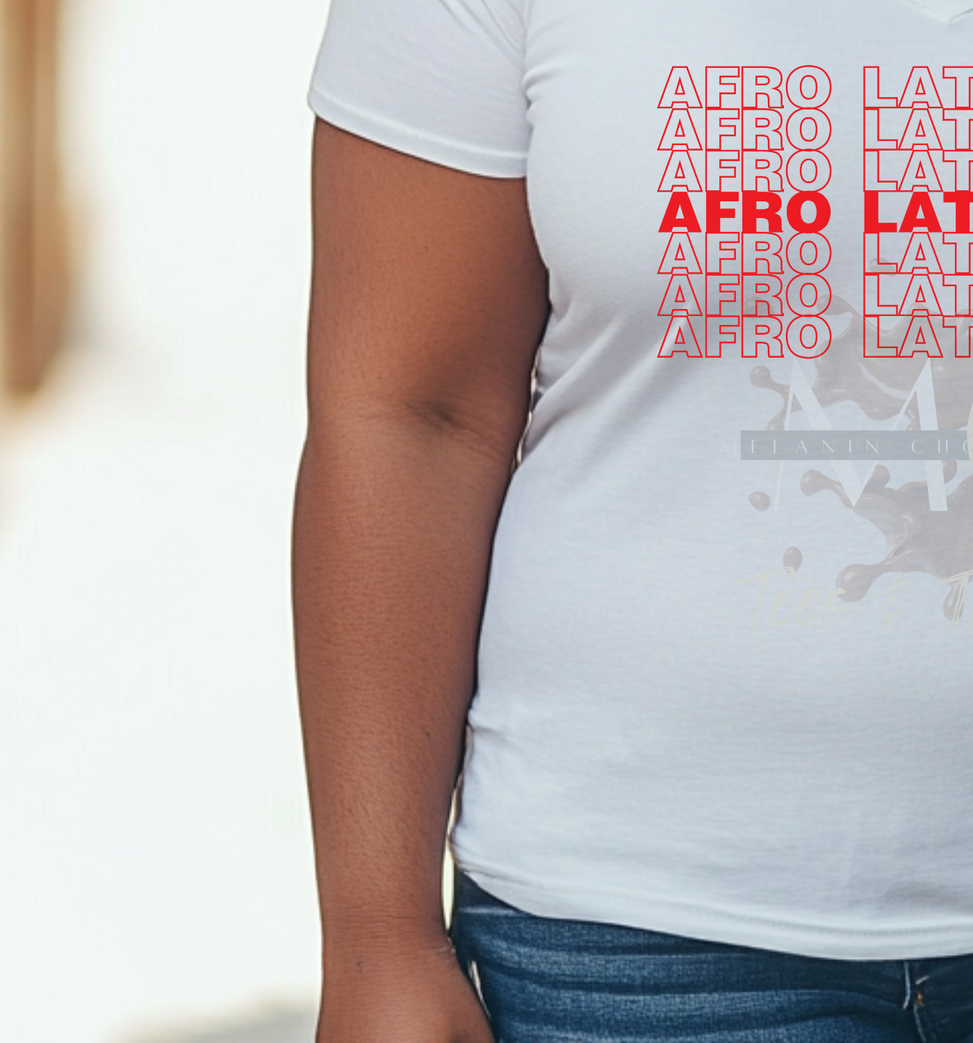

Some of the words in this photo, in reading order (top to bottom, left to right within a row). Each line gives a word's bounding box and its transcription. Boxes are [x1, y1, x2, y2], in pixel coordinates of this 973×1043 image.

[657, 65, 832, 109] AFRO
[657, 107, 832, 151] AFRO
[657, 149, 832, 192] AFRO
[657, 191, 832, 233] AFRO
[657, 232, 832, 275] AFRO
[657, 273, 832, 317] AFRO
[657, 314, 832, 358] AFRO
